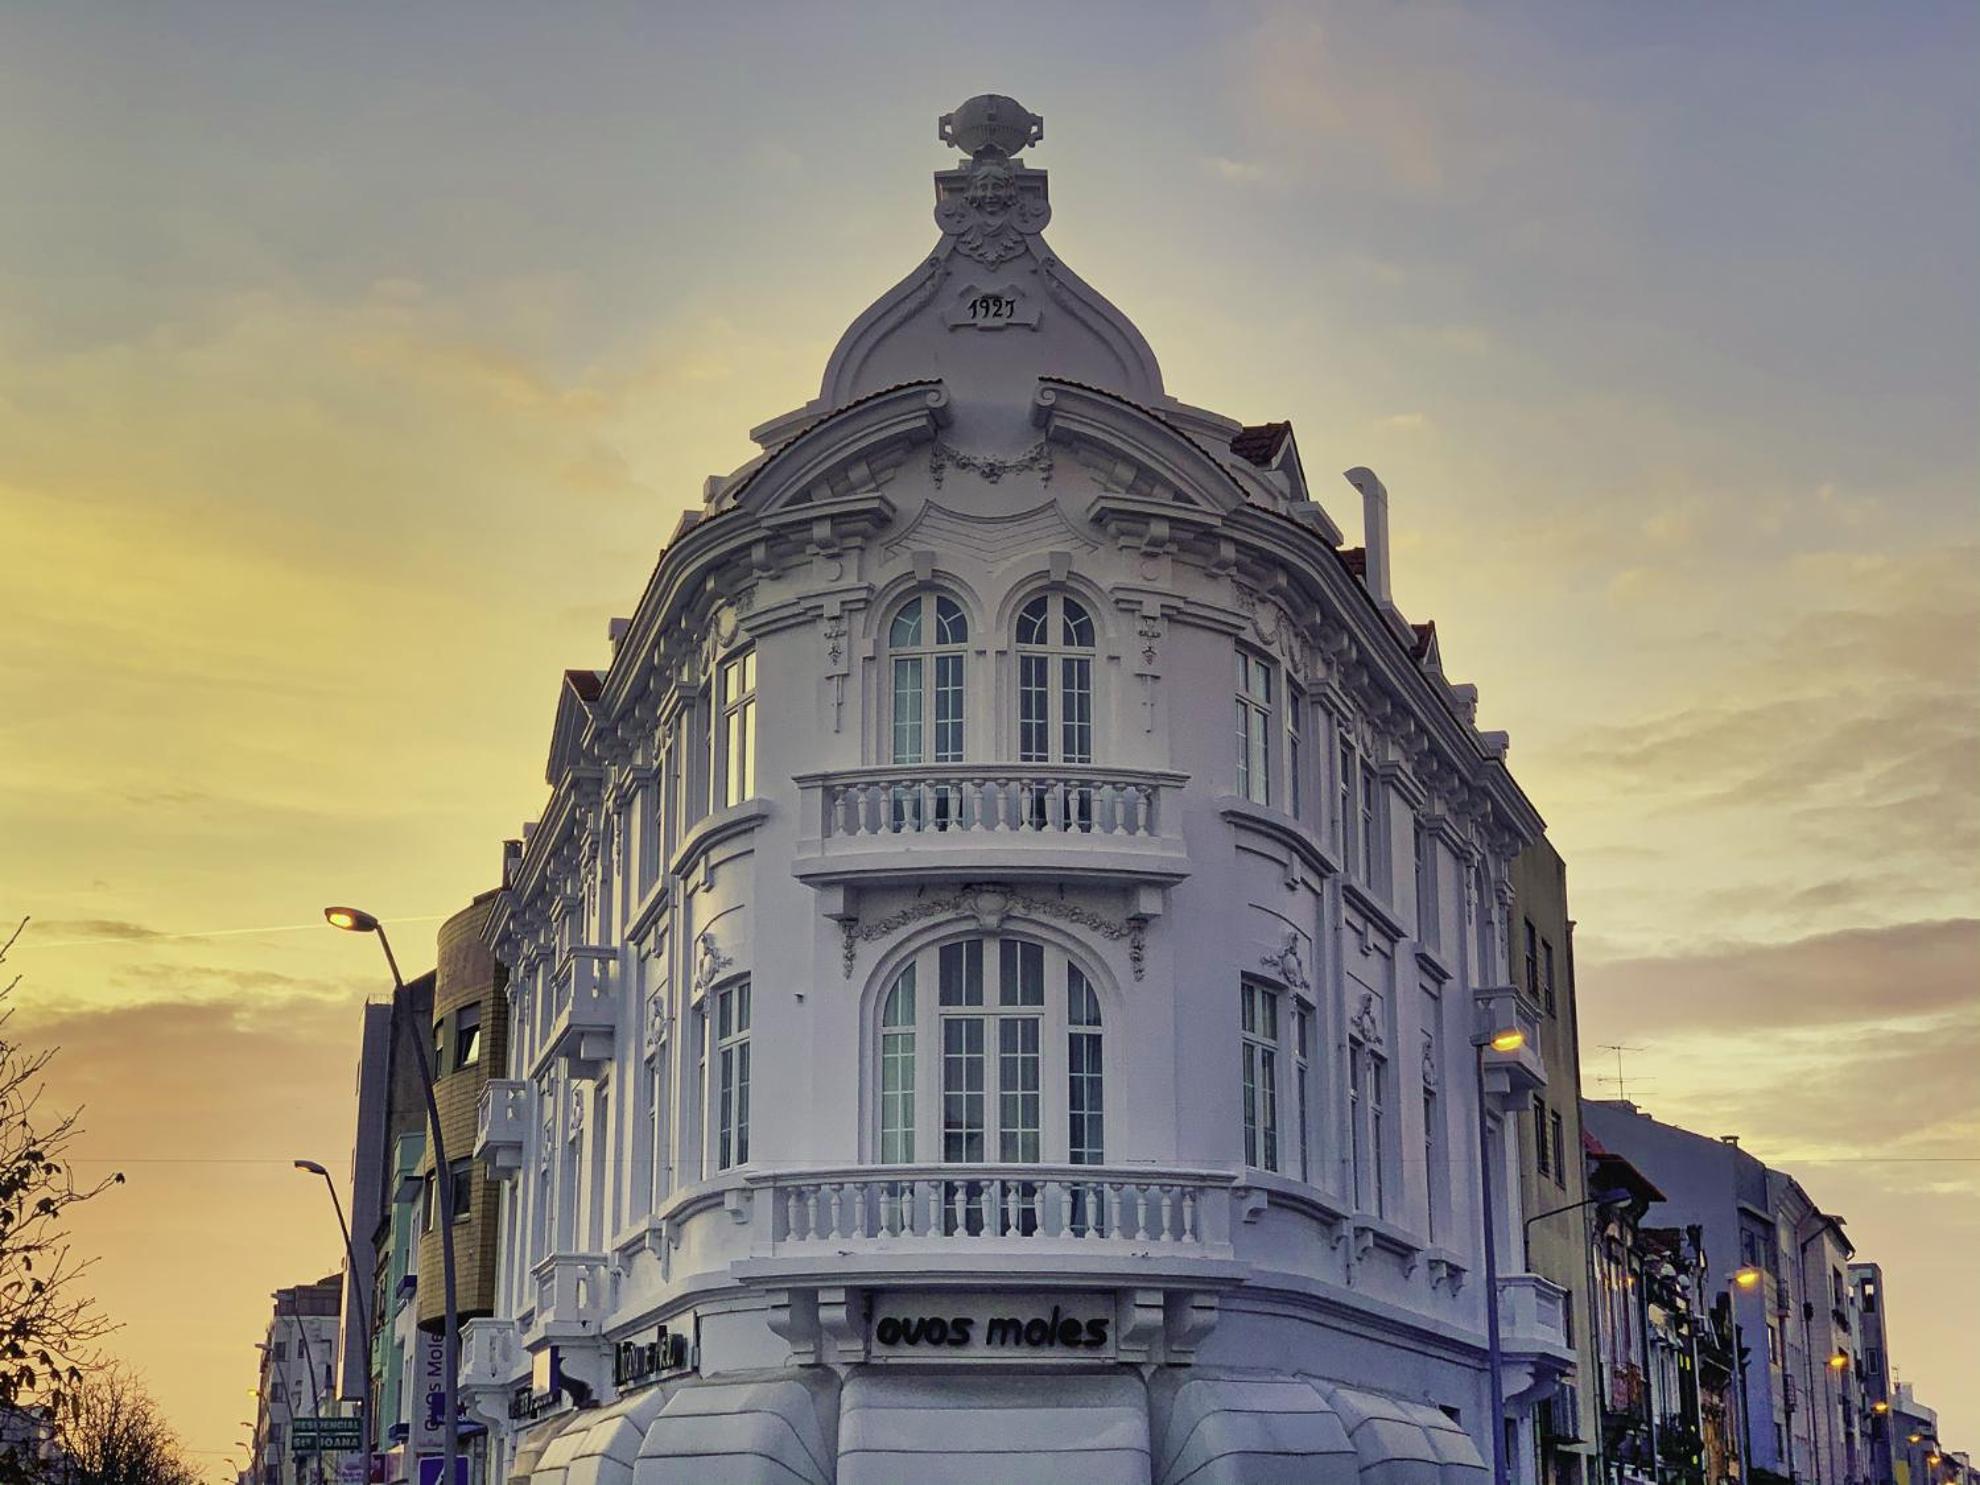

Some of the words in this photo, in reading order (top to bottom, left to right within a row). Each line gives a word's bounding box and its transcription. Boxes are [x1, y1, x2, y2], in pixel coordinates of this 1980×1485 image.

[876, 1317, 974, 1346] ovos
[986, 1305, 1110, 1347] moles
[428, 1334, 443, 1377] Mole
[425, 1383, 441, 1431] Oos
